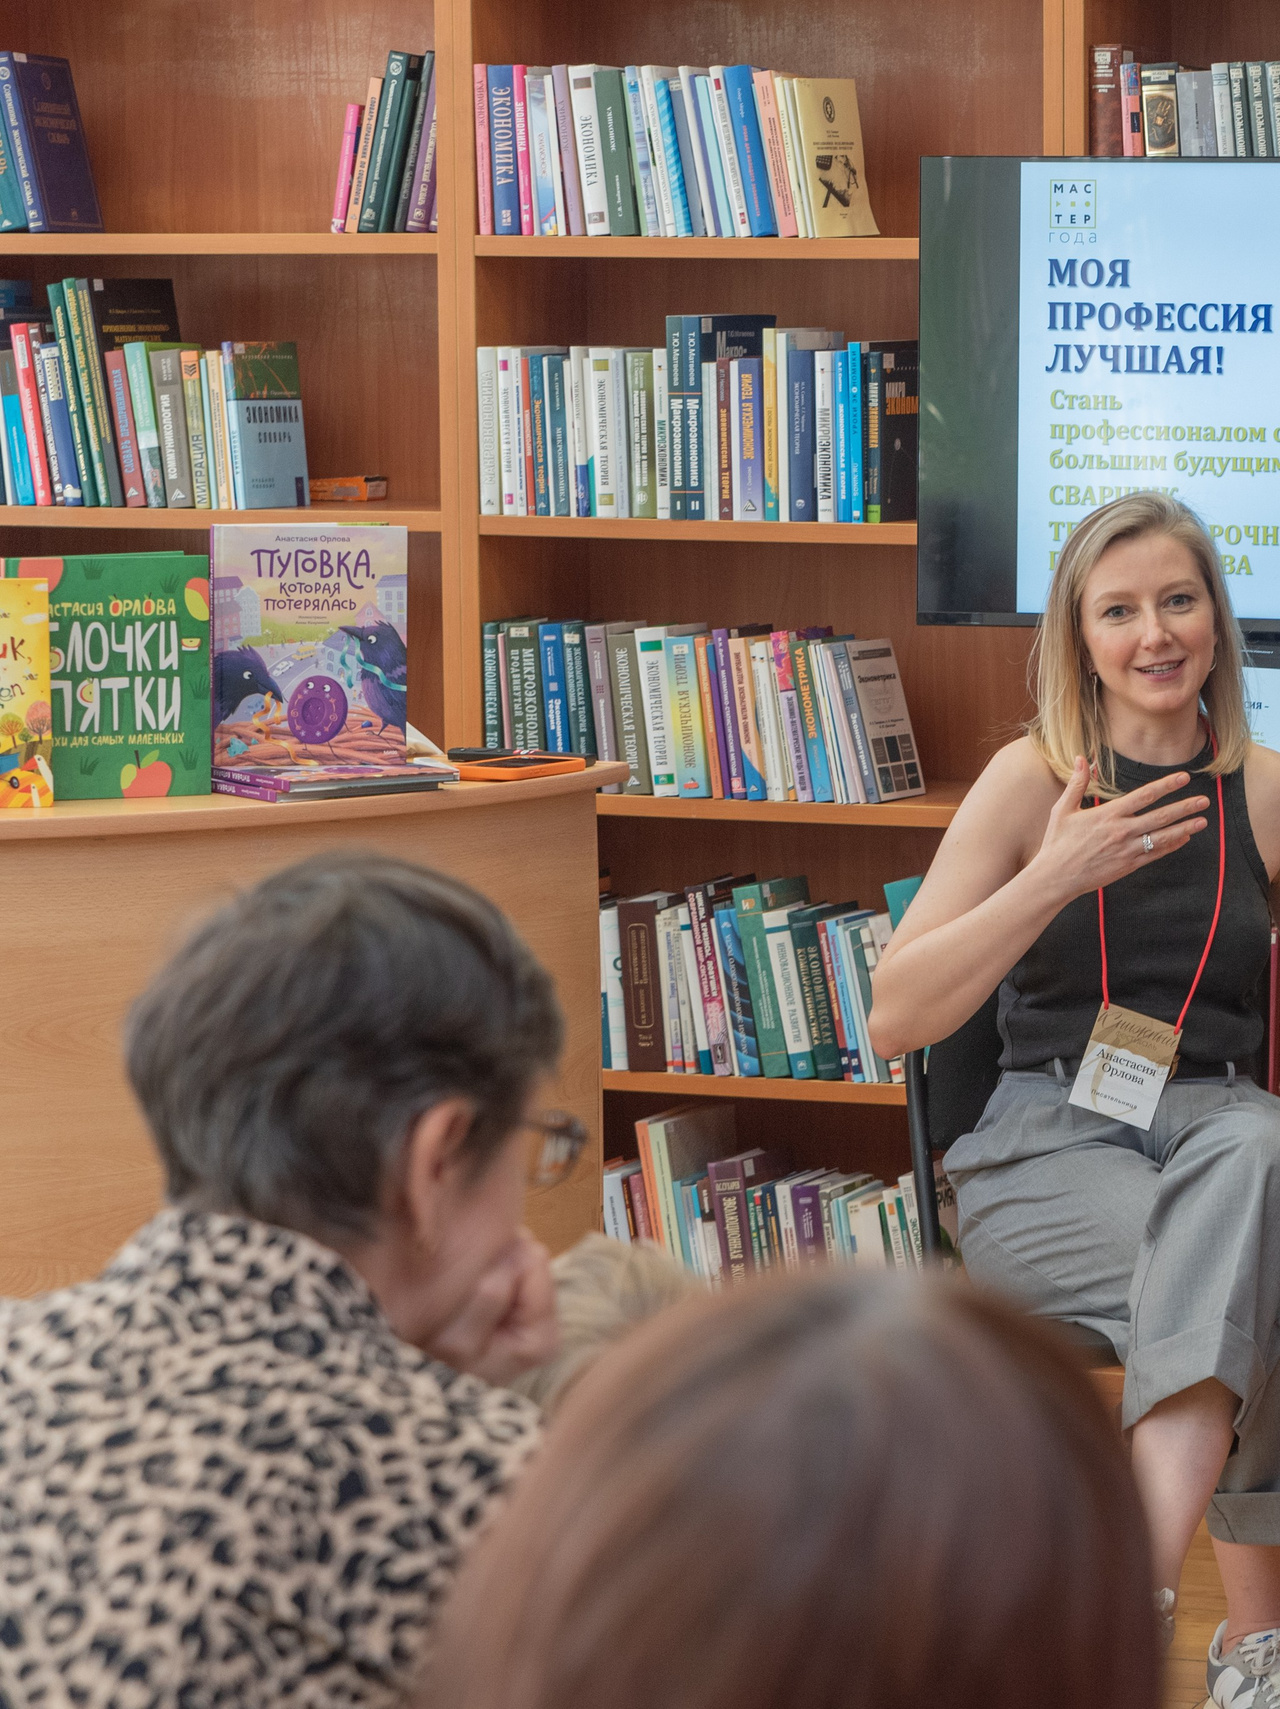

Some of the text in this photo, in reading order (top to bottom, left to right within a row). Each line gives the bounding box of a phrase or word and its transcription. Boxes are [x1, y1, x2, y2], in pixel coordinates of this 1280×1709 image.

[476, 79, 486, 131] ЭКОНОМИКА
[491, 86, 515, 187] ЭКОНОМИКА
[515, 101, 527, 152] ЭКОНОМИКА
[558, 99, 570, 154] ЭКОНОМИКА
[605, 105, 617, 154] ЭКОНОМИКА
[579, 115, 598, 187] ЭКОНОМИКА
[1053, 183, 1092, 195] МАС
[1054, 213, 1092, 225] ТЕР
[1048, 230, 1098, 245] года
[1047, 258, 1131, 288] МОЯ
[1046, 301, 1273, 333] ПРОФЕССИЯ
[671, 331, 680, 387] Т.Ю.Матвеева
[687, 331, 696, 387] Т.Ю.Матвеева
[1045, 343, 1225, 375] ЛУЧШАЯ!
[111, 368, 135, 474] СЛОВАРЬ ПРЕДПРИНИМАТЕЛЯ
[246, 405, 300, 424] ЭКОНОМИКА
[480, 369, 496, 485] МАКРОЭКОНОМИКА
[501, 387, 513, 473] ЭКОНОМИЧЕСКАЯ ТЕОРИЯ
[596, 378, 610, 486] ЭКОНОМИЧЕСКАЯ ТЕОРИЯ
[740, 373, 755, 460] ЭКОНОМИЧЕСКАЯ ТЕОРИЯ
[868, 381, 879, 449] МИКРОЭКОНОМИКА
[1049, 389, 1122, 411] Стань
[1049, 421, 1266, 446] профессионалом
[159, 393, 178, 481] КОММУНИКОЛОГИЯ
[191, 434, 208, 506] МИГРАЦИЯ
[257, 431, 292, 444] СЛОВАРЬ
[534, 399, 546, 494] Экономическая теория
[555, 426, 566, 503] МИКРОЭКОНОМИКА
[655, 419, 668, 488] МИКРОЭКОНОМИКА
[670, 398, 684, 487] Макроэкономика
[686, 398, 700, 487] Макроэкономика
[719, 407, 730, 499] ЭКОНОМИЧЕСКАЯ ТЕОРИЯ
[817, 407, 832, 500] МИКРОЭКОНОМИКА
[838, 403, 847, 500] ЭКОНОМИЧЕСКАЯ ТЕОРИЯ
[1049, 451, 1167, 473] большим
[250, 548, 376, 589] ПУГОВКА,
[275, 534, 351, 544] Анастасия Орлова
[109, 598, 176, 617] ОРЛОВА
[484, 647, 498, 725] ЭКОНОМИЧЕСКАЯ
[509, 648, 525, 717] ПРОДВИНУТЫЙ
[565, 647, 577, 712] МИКРОЭКОНОМИКА
[573, 647, 587, 733] ЭКОНОМИЧЕСКАЯ ТЕОРИЯ
[615, 647, 639, 770] ЭКОНОМИЧЕСКАЯ ТЕОРИЯ
[794, 646, 818, 739] ЭКОНОМЕТРИКА
[857, 672, 897, 684] Эконометрика
[70, 732, 185, 749] ДЛЯ САМЫХ МАЛЕНЬКИХ
[548, 698, 557, 730] теория
[598, 698, 609, 753] Экономическая
[646, 660, 668, 766] ЭКОНОМИЧЕСКАЯ ТЕОРИЯ
[677, 690, 696, 769] ЭКОНОМИЧЕСКАЯ
[721, 669, 738, 777] МАТЕМАТИКО-СТАТИСТИЧЕСКИЕ МЕТОДЫ
[849, 712, 869, 777] Эконометрика
[687, 892, 711, 998] СОВРЕМЕННОЙ МИР-СИСТЕМЫ
[694, 891, 718, 997] ЦИКЛЫ, КРИЗИСЫ, ЛОВУШКИ
[776, 942, 803, 1044] ИННОВАЦИОННОЕ РАЗВИТИЕ
[795, 947, 821, 1047] КОМПАРАТИВИСТИКА
[807, 945, 833, 1046] ЭКОНОМИЧЕСКАЯ
[1096, 1048, 1158, 1077] Анастасия
[1101, 1062, 1145, 1086] Орлова
[1090, 1088, 1138, 1110] Писательница
[722, 1196, 744, 1260] ЭВОЛЮЦИОННАЯ
